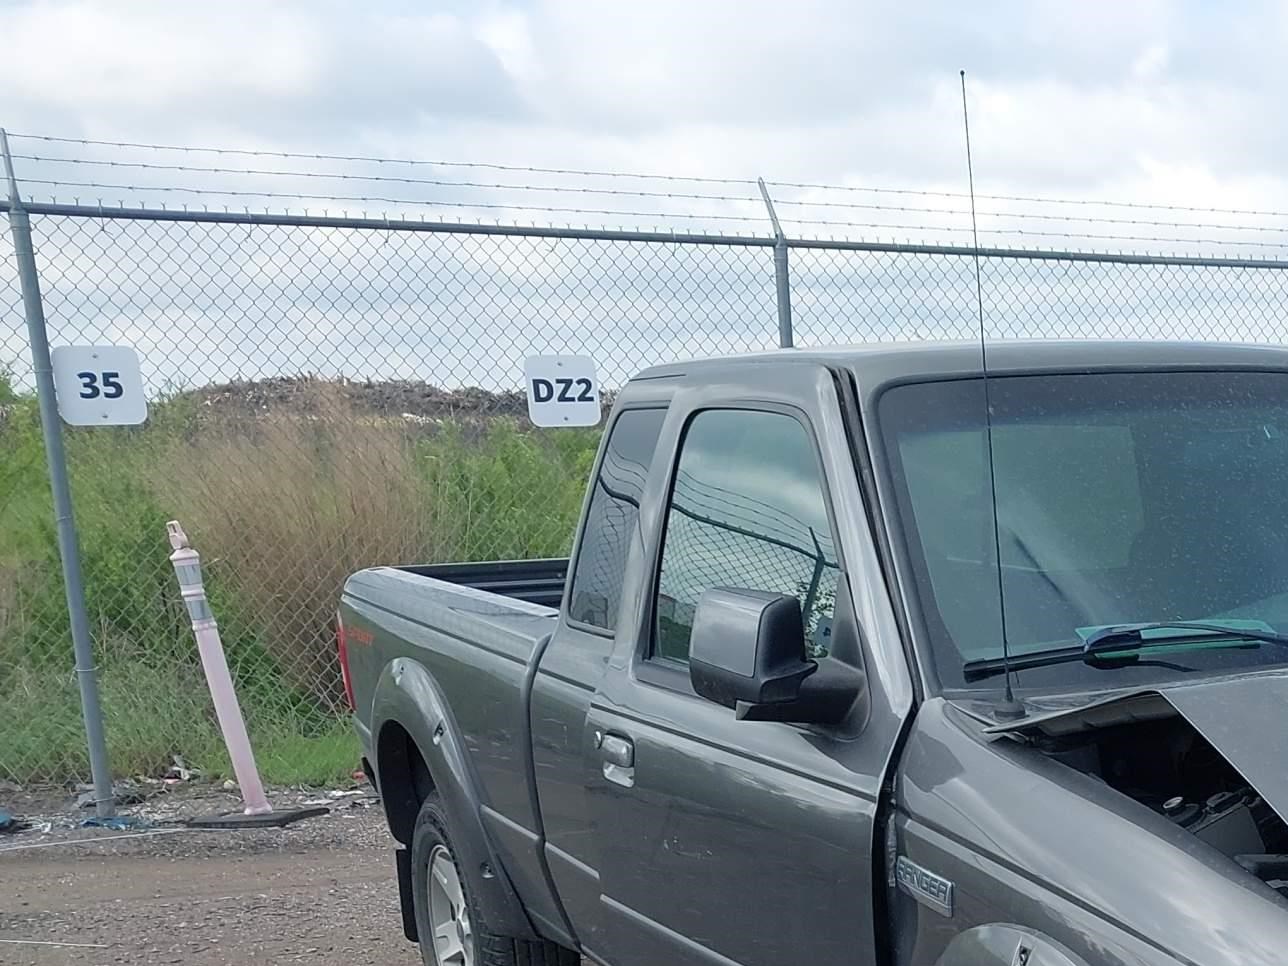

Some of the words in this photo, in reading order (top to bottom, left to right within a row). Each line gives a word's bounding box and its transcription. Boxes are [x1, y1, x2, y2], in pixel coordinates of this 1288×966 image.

[77, 371, 124, 399] 35
[532, 377, 595, 403] DZ2
[896, 860, 947, 904] RANGER
